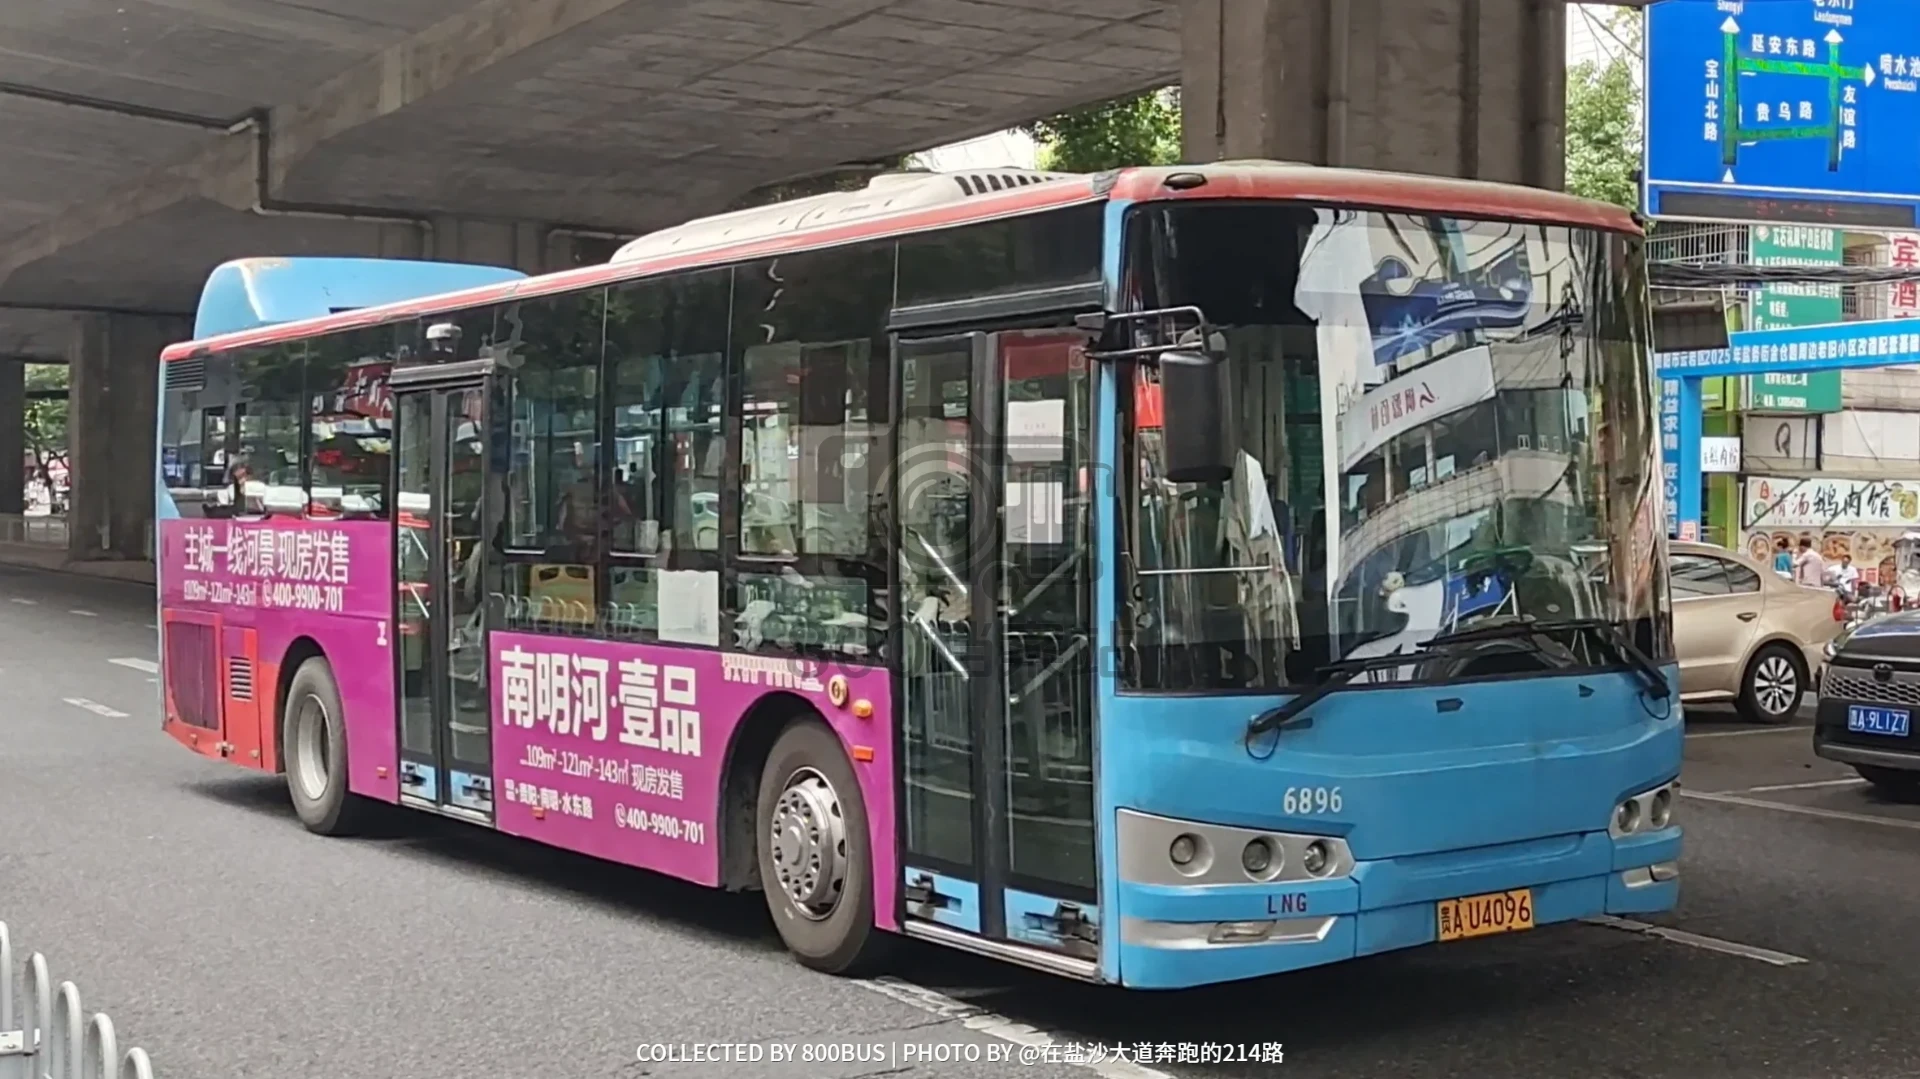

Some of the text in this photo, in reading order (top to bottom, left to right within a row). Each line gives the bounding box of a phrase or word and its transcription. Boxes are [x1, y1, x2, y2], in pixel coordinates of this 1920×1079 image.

[1751, 34, 1816, 58] 延安东路
[1880, 53, 1920, 78] 喷水池
[1704, 59, 1719, 141] 宝山北路
[1756, 101, 1813, 122] 贵乌路
[1843, 85, 1856, 149] 友谊路
[1892, 236, 1920, 319] 宾酒
[1771, 483, 1890, 518] 清汤鹅肉馆
[184, 526, 350, 584] 主城一线河景 现房发售
[273, 584, 343, 611] 400-9900-701
[500, 645, 702, 757] 南明河·壹品
[631, 763, 684, 801] 现房发售
[1283, 785, 1344, 814] 6896
[626, 808, 705, 846] 400-9900-701
[1267, 893, 1309, 915] LNG
